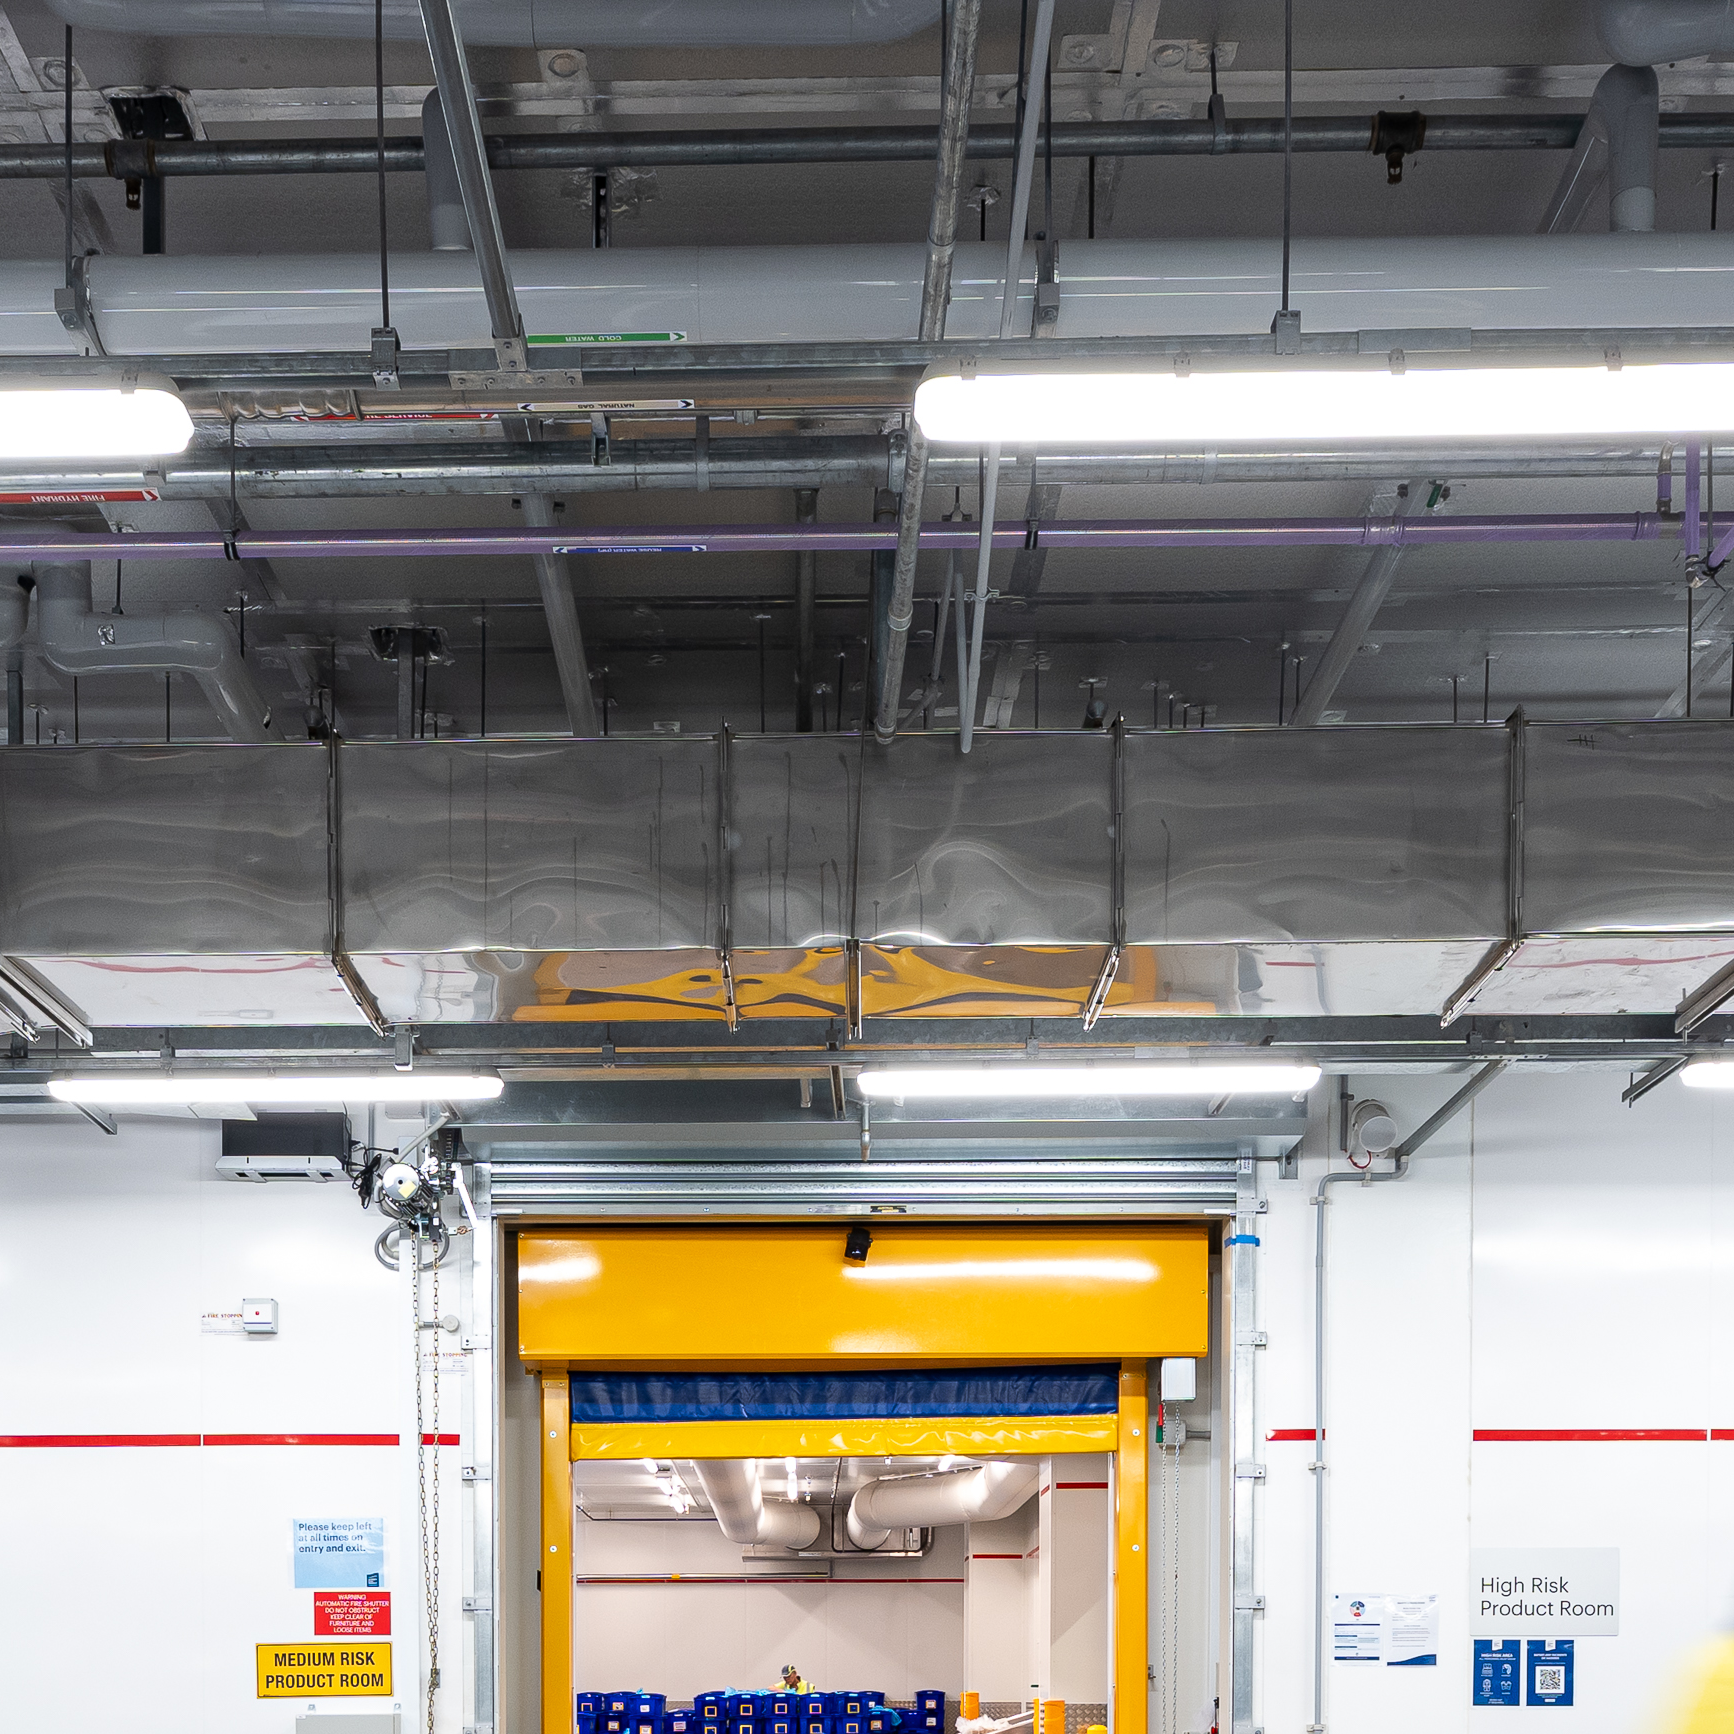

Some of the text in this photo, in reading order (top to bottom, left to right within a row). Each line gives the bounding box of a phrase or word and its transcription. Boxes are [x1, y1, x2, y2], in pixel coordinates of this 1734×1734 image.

[30, 495, 80, 503] HYDRANT
[298, 1522, 372, 1532] Please keep left
[298, 1534, 308, 1542] at
[310, 1533, 321, 1542] all
[323, 1533, 349, 1542] times
[298, 1544, 366, 1554] entry and exit.
[1480, 1576, 1569, 1597] High Risk
[1480, 1599, 1614, 1616] Product Room
[274, 1651, 376, 1667] MEDIUM RISK
[265, 1673, 384, 1689] PRODUCT ROOM
